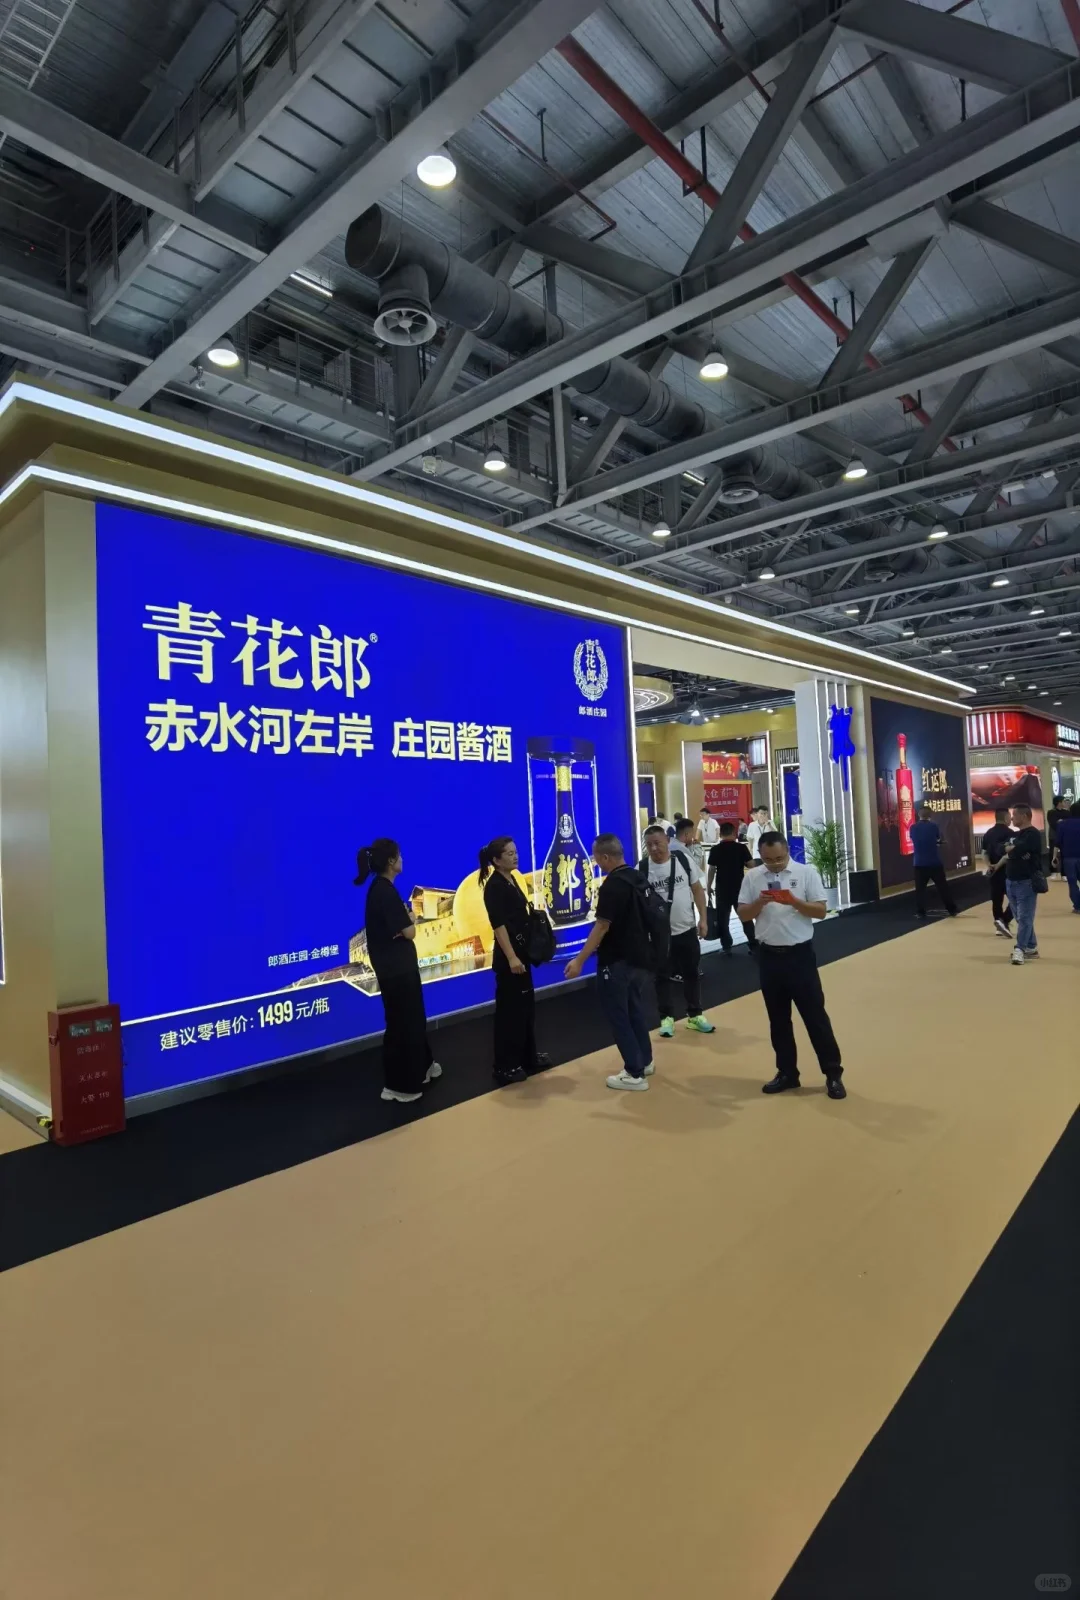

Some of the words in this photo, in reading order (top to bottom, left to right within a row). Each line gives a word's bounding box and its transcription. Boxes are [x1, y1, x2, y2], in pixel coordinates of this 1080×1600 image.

[141, 600, 371, 698] 青花郎
[144, 698, 374, 757] 赤水河左岸
[392, 716, 513, 764] 庄园酱酒
[578, 705, 608, 718] 郎酒庄园
[267, 944, 339, 968] 郎酒庄园·金樽堡
